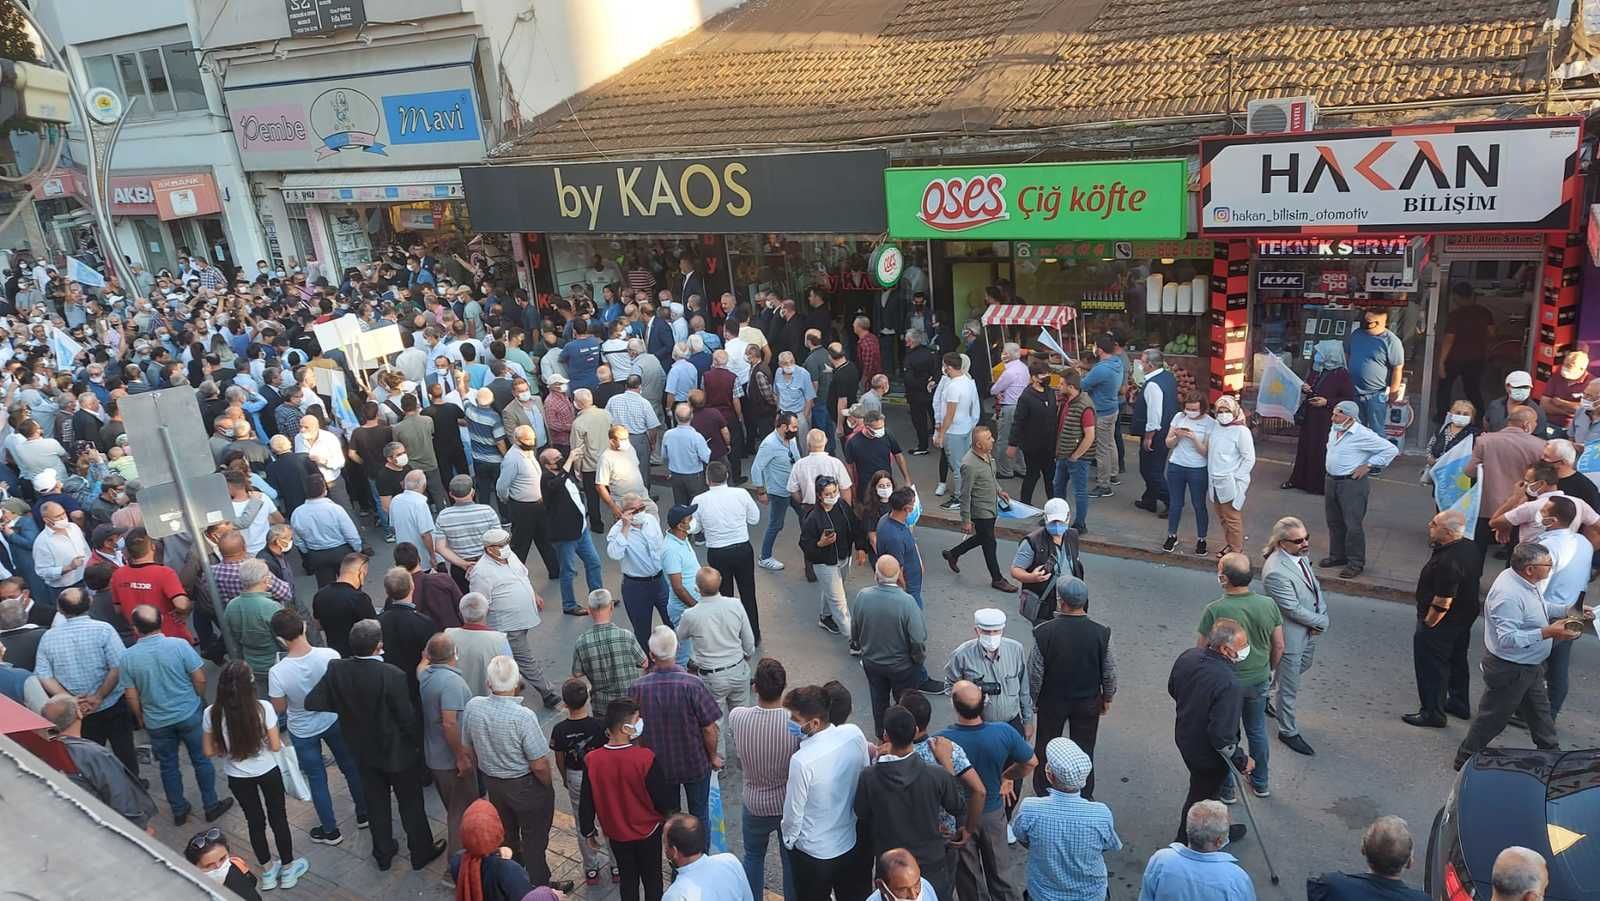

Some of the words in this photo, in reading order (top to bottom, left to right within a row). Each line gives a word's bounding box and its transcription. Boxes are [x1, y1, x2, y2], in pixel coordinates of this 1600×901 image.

[240, 114, 306, 150] Pembe
[399, 104, 464, 136] Mavi
[1261, 140, 1501, 194] HAKAN
[553, 167, 603, 231] by
[616, 162, 753, 217] KAOS
[922, 175, 1005, 220] oses
[1017, 183, 1062, 220] Çiğ
[1070, 181, 1148, 220] köfte
[1403, 195, 1497, 215] BİLİŞİM
[1232, 207, 1368, 223] hakan_bilisim_otomotiv
[1257, 237, 1334, 255] TEKNİK
[1338, 235, 1409, 255] SERVİ
[1322, 273, 1347, 283] gen
[1328, 281, 1347, 291] pa
